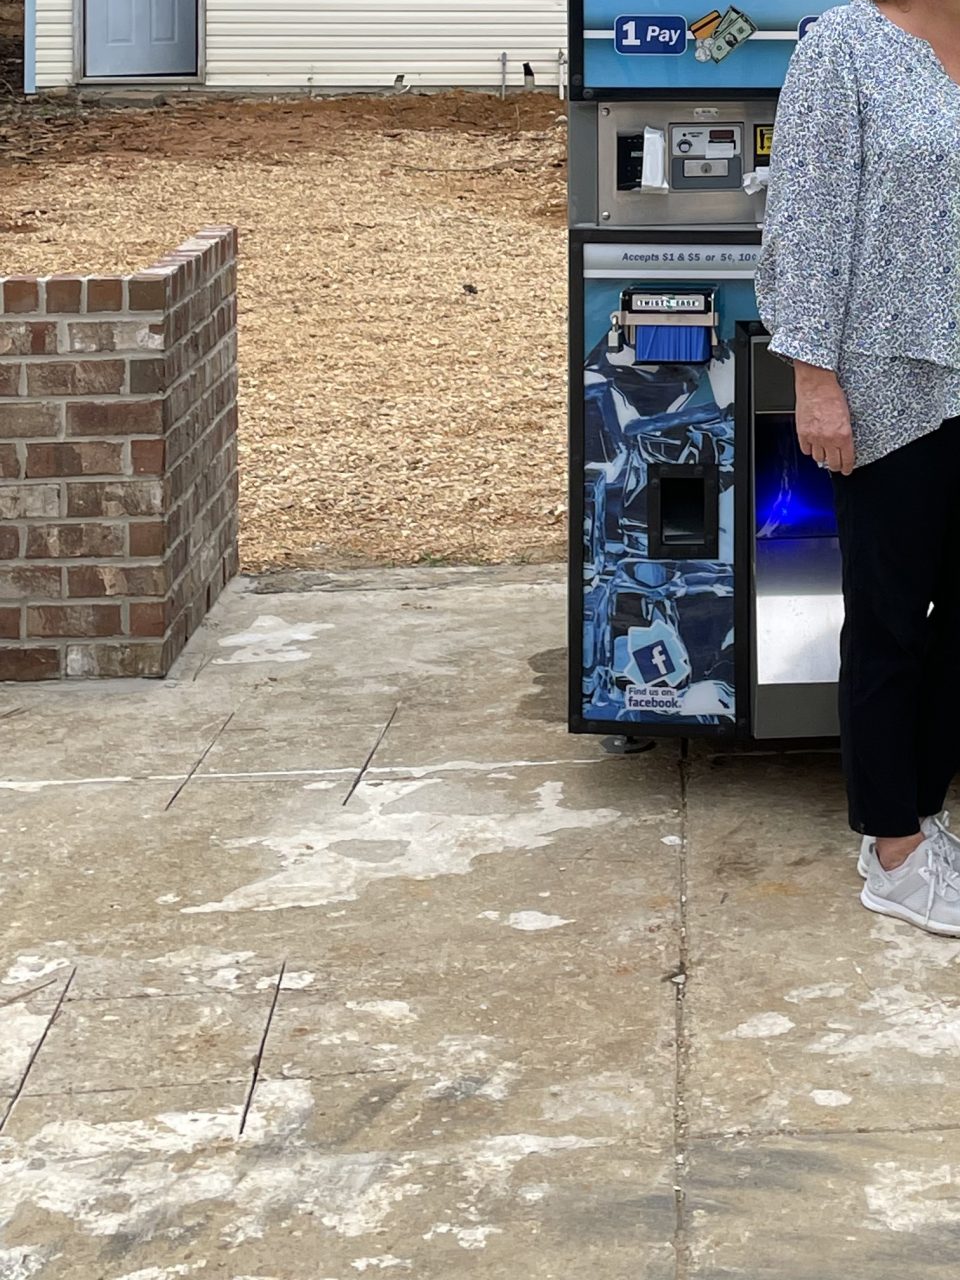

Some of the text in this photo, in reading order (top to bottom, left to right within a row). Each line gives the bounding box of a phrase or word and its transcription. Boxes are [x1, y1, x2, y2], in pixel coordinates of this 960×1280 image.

[622, 20, 681, 46] 1 Pay
[622, 252, 660, 263] Accepts
[662, 252, 674, 262] $1
[677, 252, 685, 262] &
[687, 252, 701, 262] $5
[705, 254, 716, 262] or
[651, 644, 667, 675] f
[628, 687, 647, 696] Find
